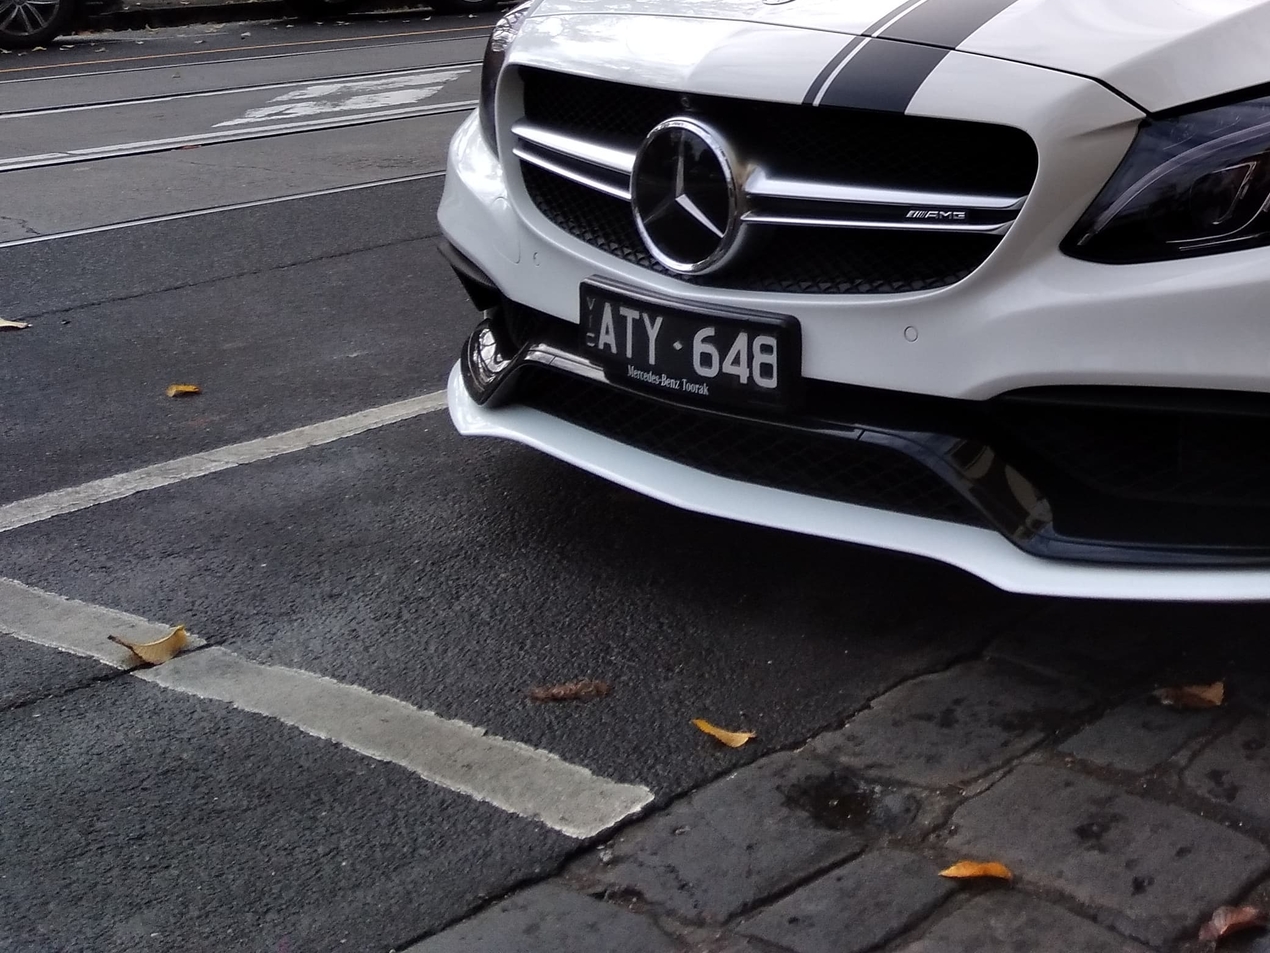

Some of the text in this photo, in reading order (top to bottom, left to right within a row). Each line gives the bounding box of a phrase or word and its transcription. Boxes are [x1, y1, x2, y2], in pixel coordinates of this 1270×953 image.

[598, 302, 778, 389] ATY 648
[627, 365, 709, 396] Mercedes-Benz Toorak
